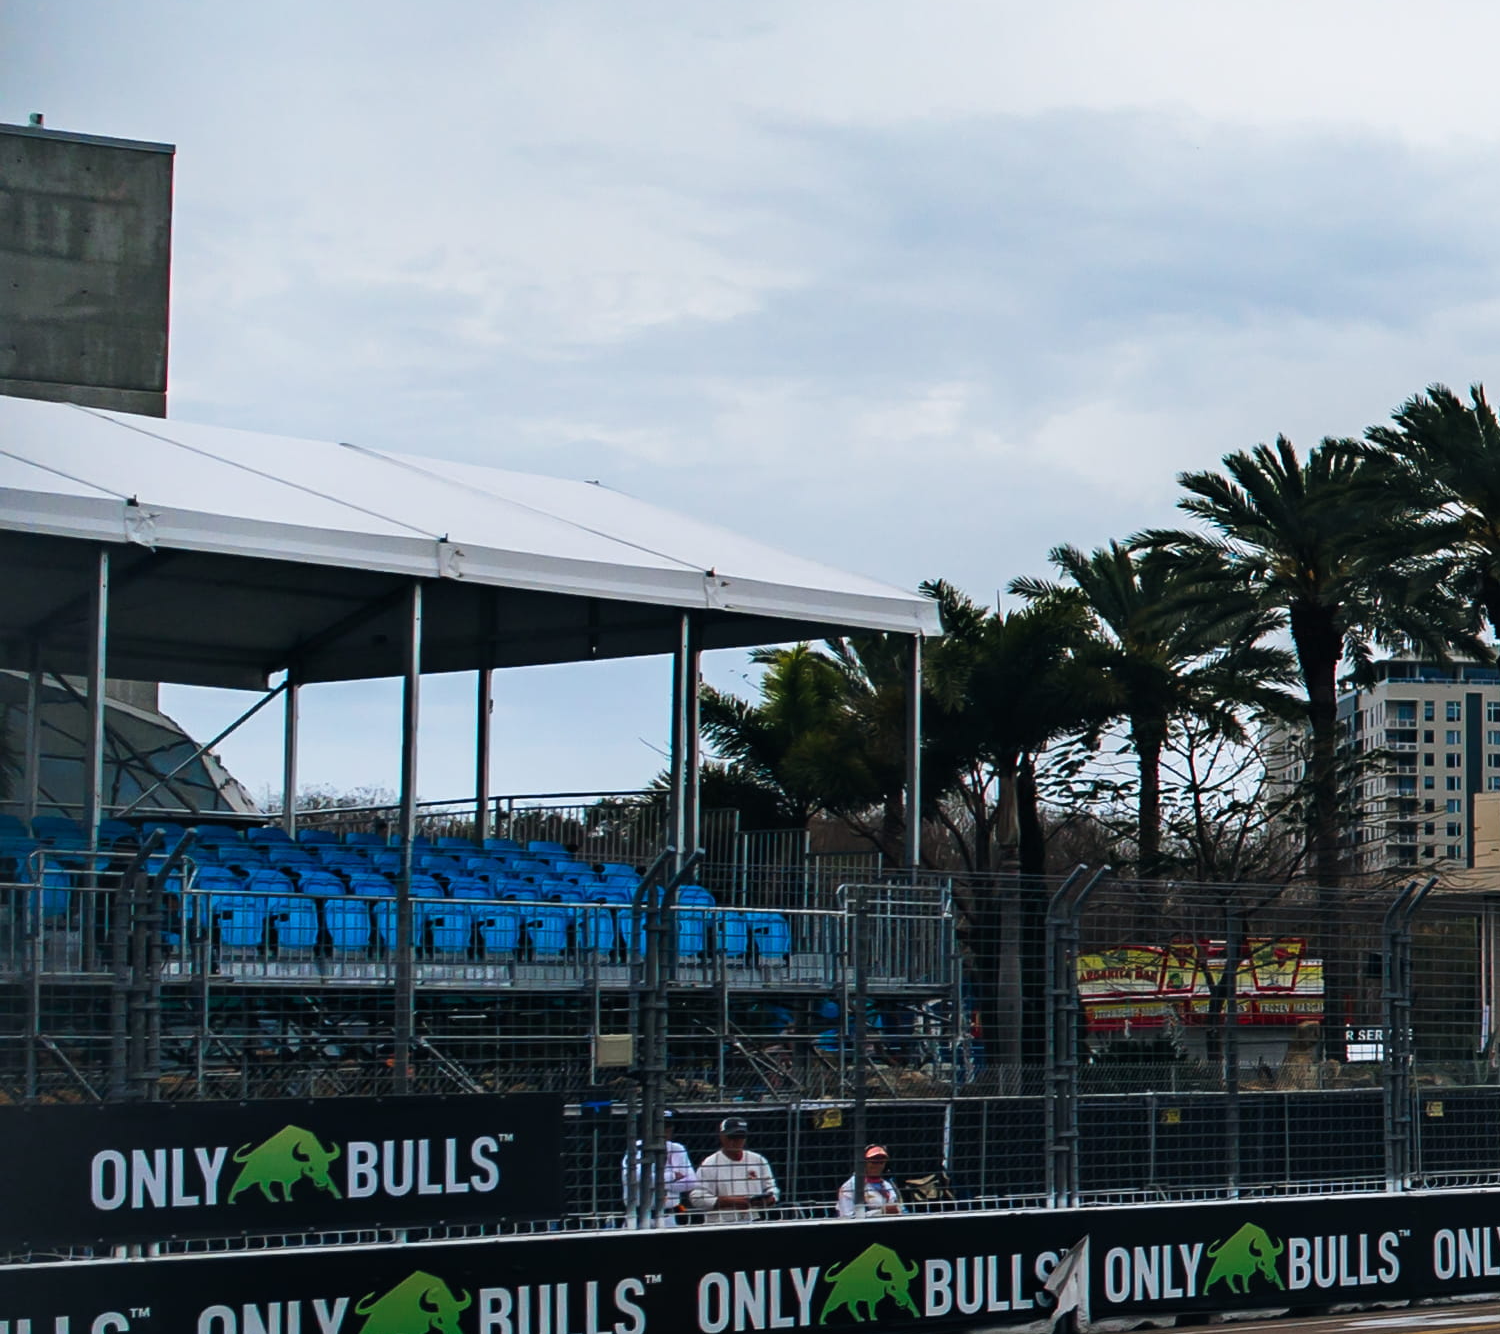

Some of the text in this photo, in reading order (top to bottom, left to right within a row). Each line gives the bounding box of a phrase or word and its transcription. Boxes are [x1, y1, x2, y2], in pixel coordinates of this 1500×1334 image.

[91, 1147, 228, 1211] ONLY
[699, 1266, 820, 1334] ONLY
[1104, 1242, 1204, 1305] ONLY
